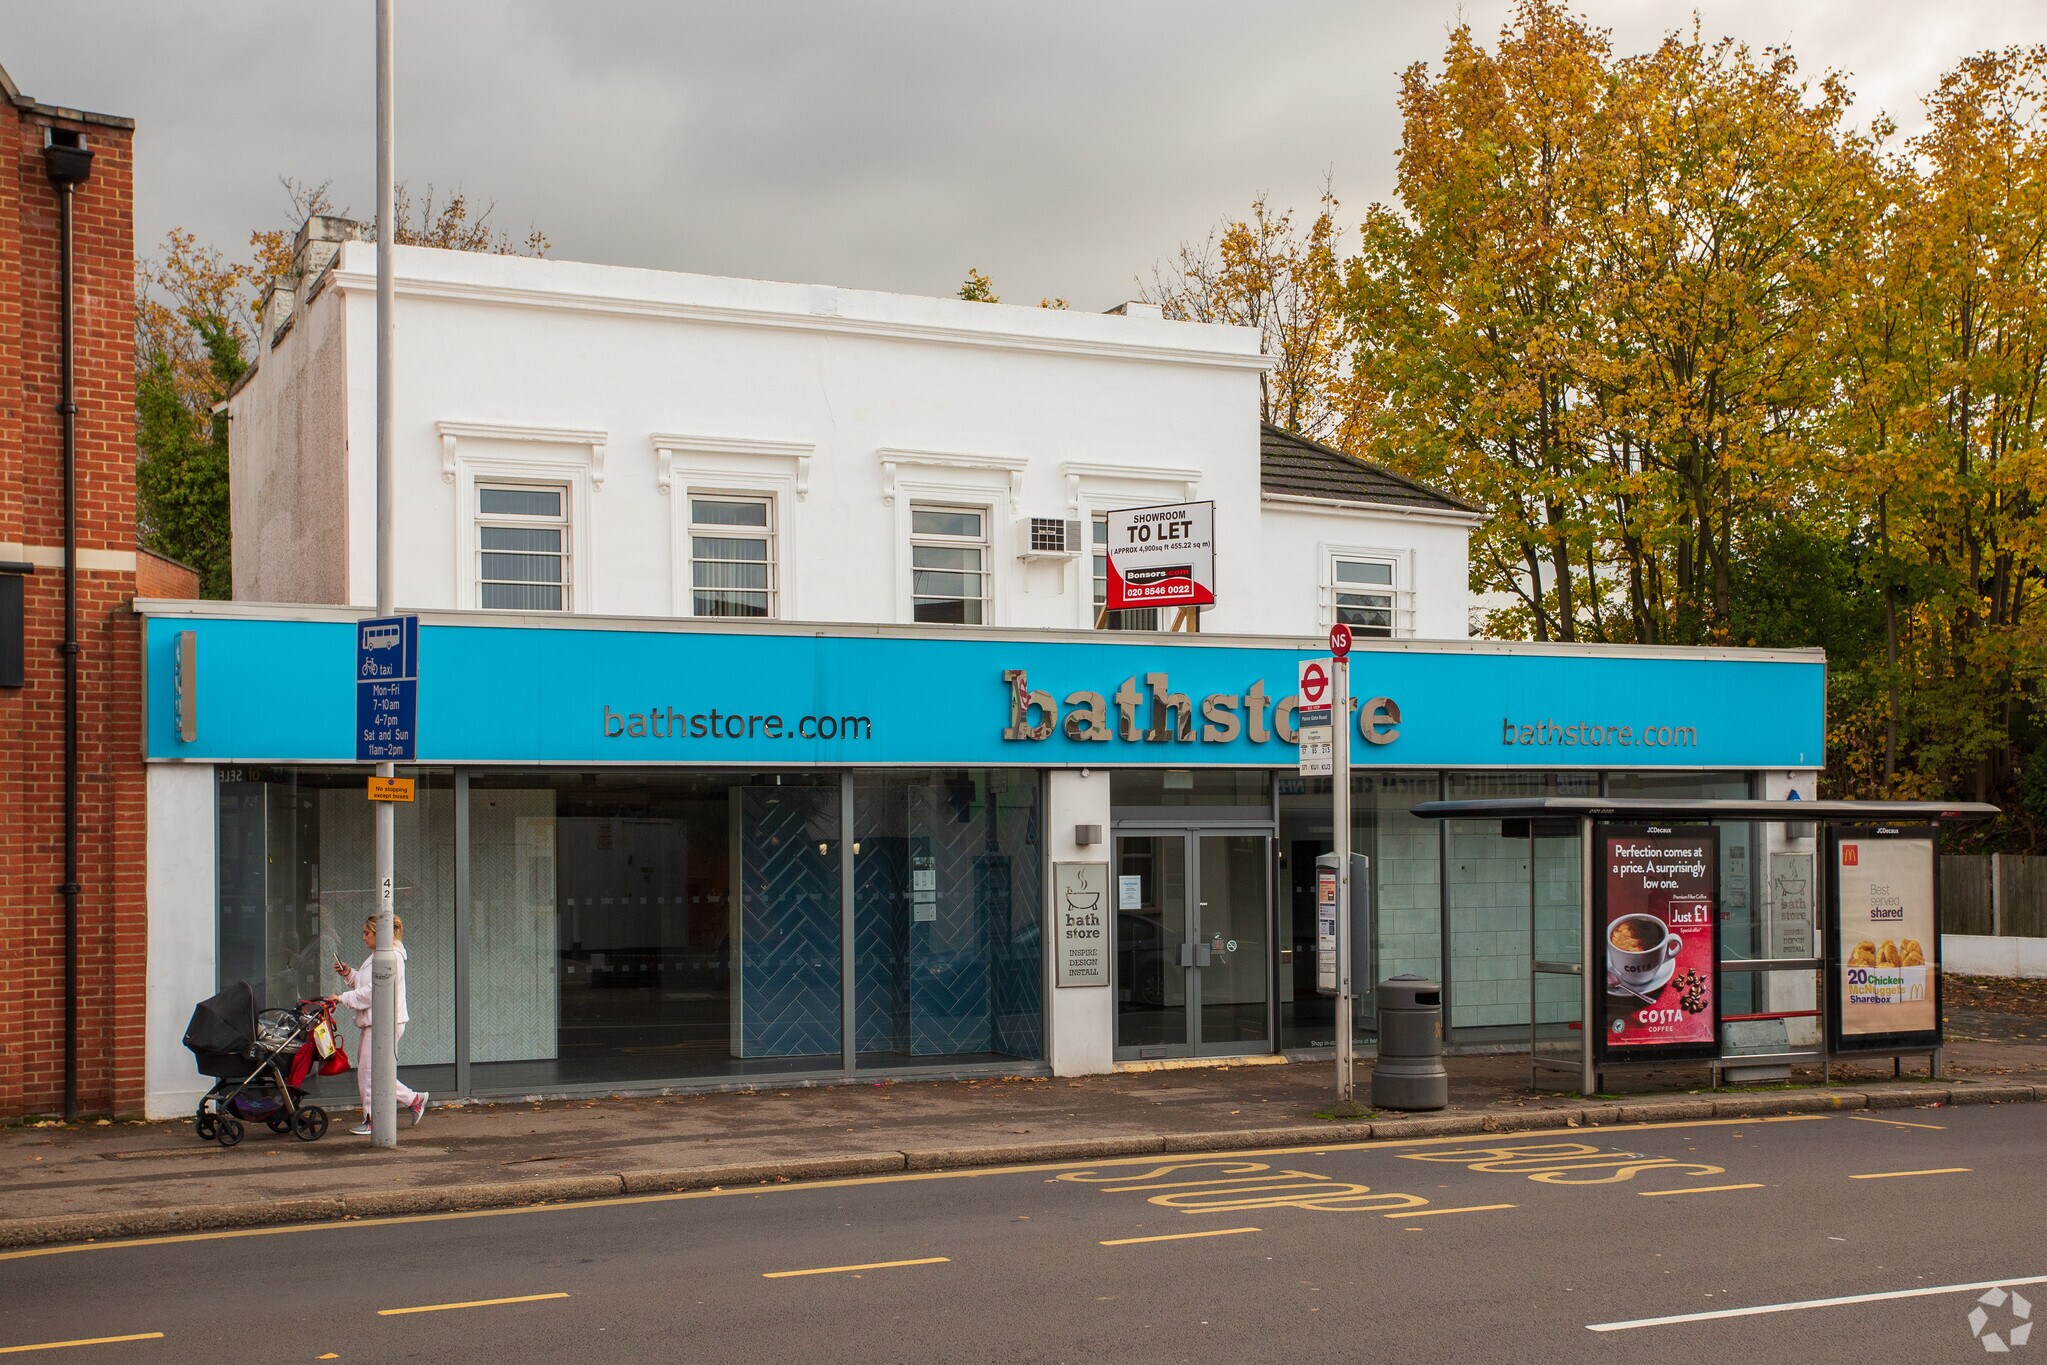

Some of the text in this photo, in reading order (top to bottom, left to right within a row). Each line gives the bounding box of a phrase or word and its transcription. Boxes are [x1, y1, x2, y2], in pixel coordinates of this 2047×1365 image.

[1134, 510, 1186, 523] SHOWROOM
[1127, 520, 1193, 543] TO LET
[1139, 544, 1163, 554] 4,900sq
[1170, 542, 1191, 550] 455.22
[1127, 585, 1190, 597] 020 8546 0022
[1332, 634, 1346, 648] NS
[380, 664, 393, 676] taxi
[373, 684, 400, 696] Mon-Fri
[373, 699, 400, 711] 7-10am
[374, 715, 398, 727] 4-7pm
[604, 705, 871, 739] bathstore.com
[364, 729, 409, 740] Sat and Sun
[1503, 718, 1697, 746] bathstore.com
[368, 744, 403, 757] 11am-2pm
[1615, 845, 1702, 858] Perfection comes at
[1613, 860, 1706, 878] a price. A surprisingly
[1643, 876, 1679, 889] low one.
[1870, 884, 1890, 895] Best
[1781, 897, 1806, 909] bath
[1870, 896, 1900, 906] served
[1672, 904, 1708, 923] Just £1
[1781, 910, 1806, 920] store
[1870, 907, 1903, 919] shared
[1066, 913, 1100, 926] bath
[1066, 928, 1100, 939] store
[1069, 949, 1098, 957] INSPIRE
[1624, 964, 1652, 973] COSTA
[1847, 969, 1904, 986] 20 Chicken
[1849, 984, 1906, 996] McNuggets
[1850, 995, 1891, 1003] Sharebox
[1639, 1009, 1683, 1024] COSTA
[1648, 1025, 1674, 1033] COFFEE
[1397, 1142, 1725, 1185] BUS
[1056, 1162, 1429, 1214] STOP
